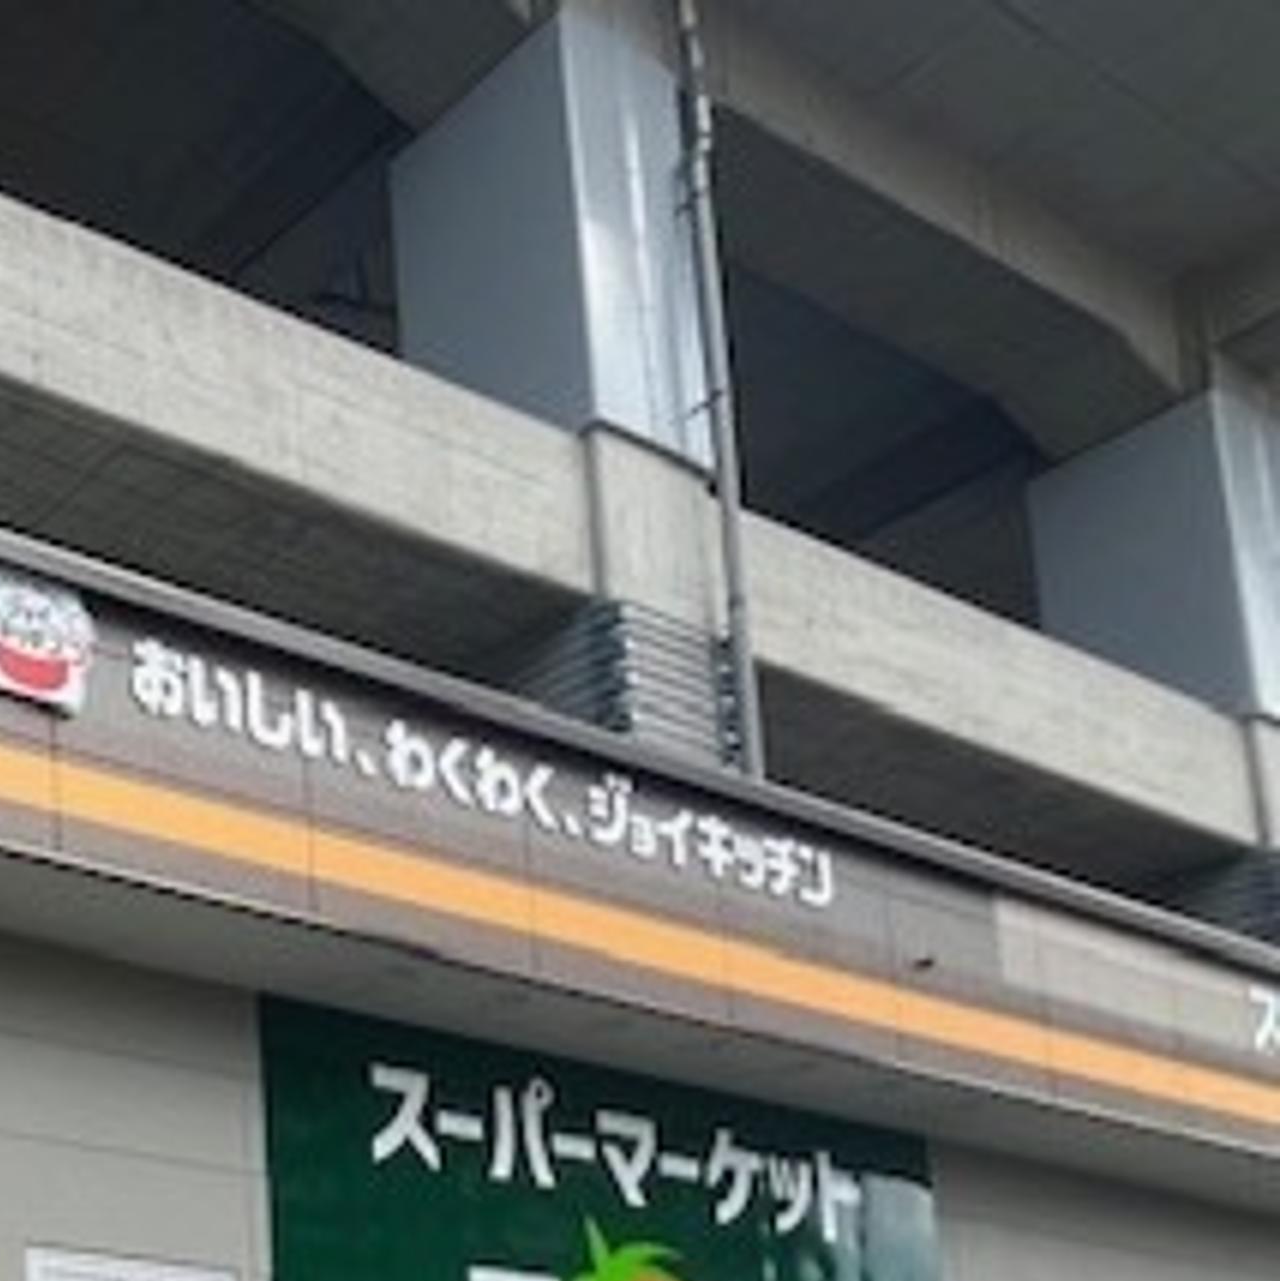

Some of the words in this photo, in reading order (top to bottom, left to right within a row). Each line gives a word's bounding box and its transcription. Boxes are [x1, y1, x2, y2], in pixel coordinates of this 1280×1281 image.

[130, 636, 836, 908] おいしい、わくわく、ジョイキッチン
[370, 1062, 861, 1242] スーパーマーケット
